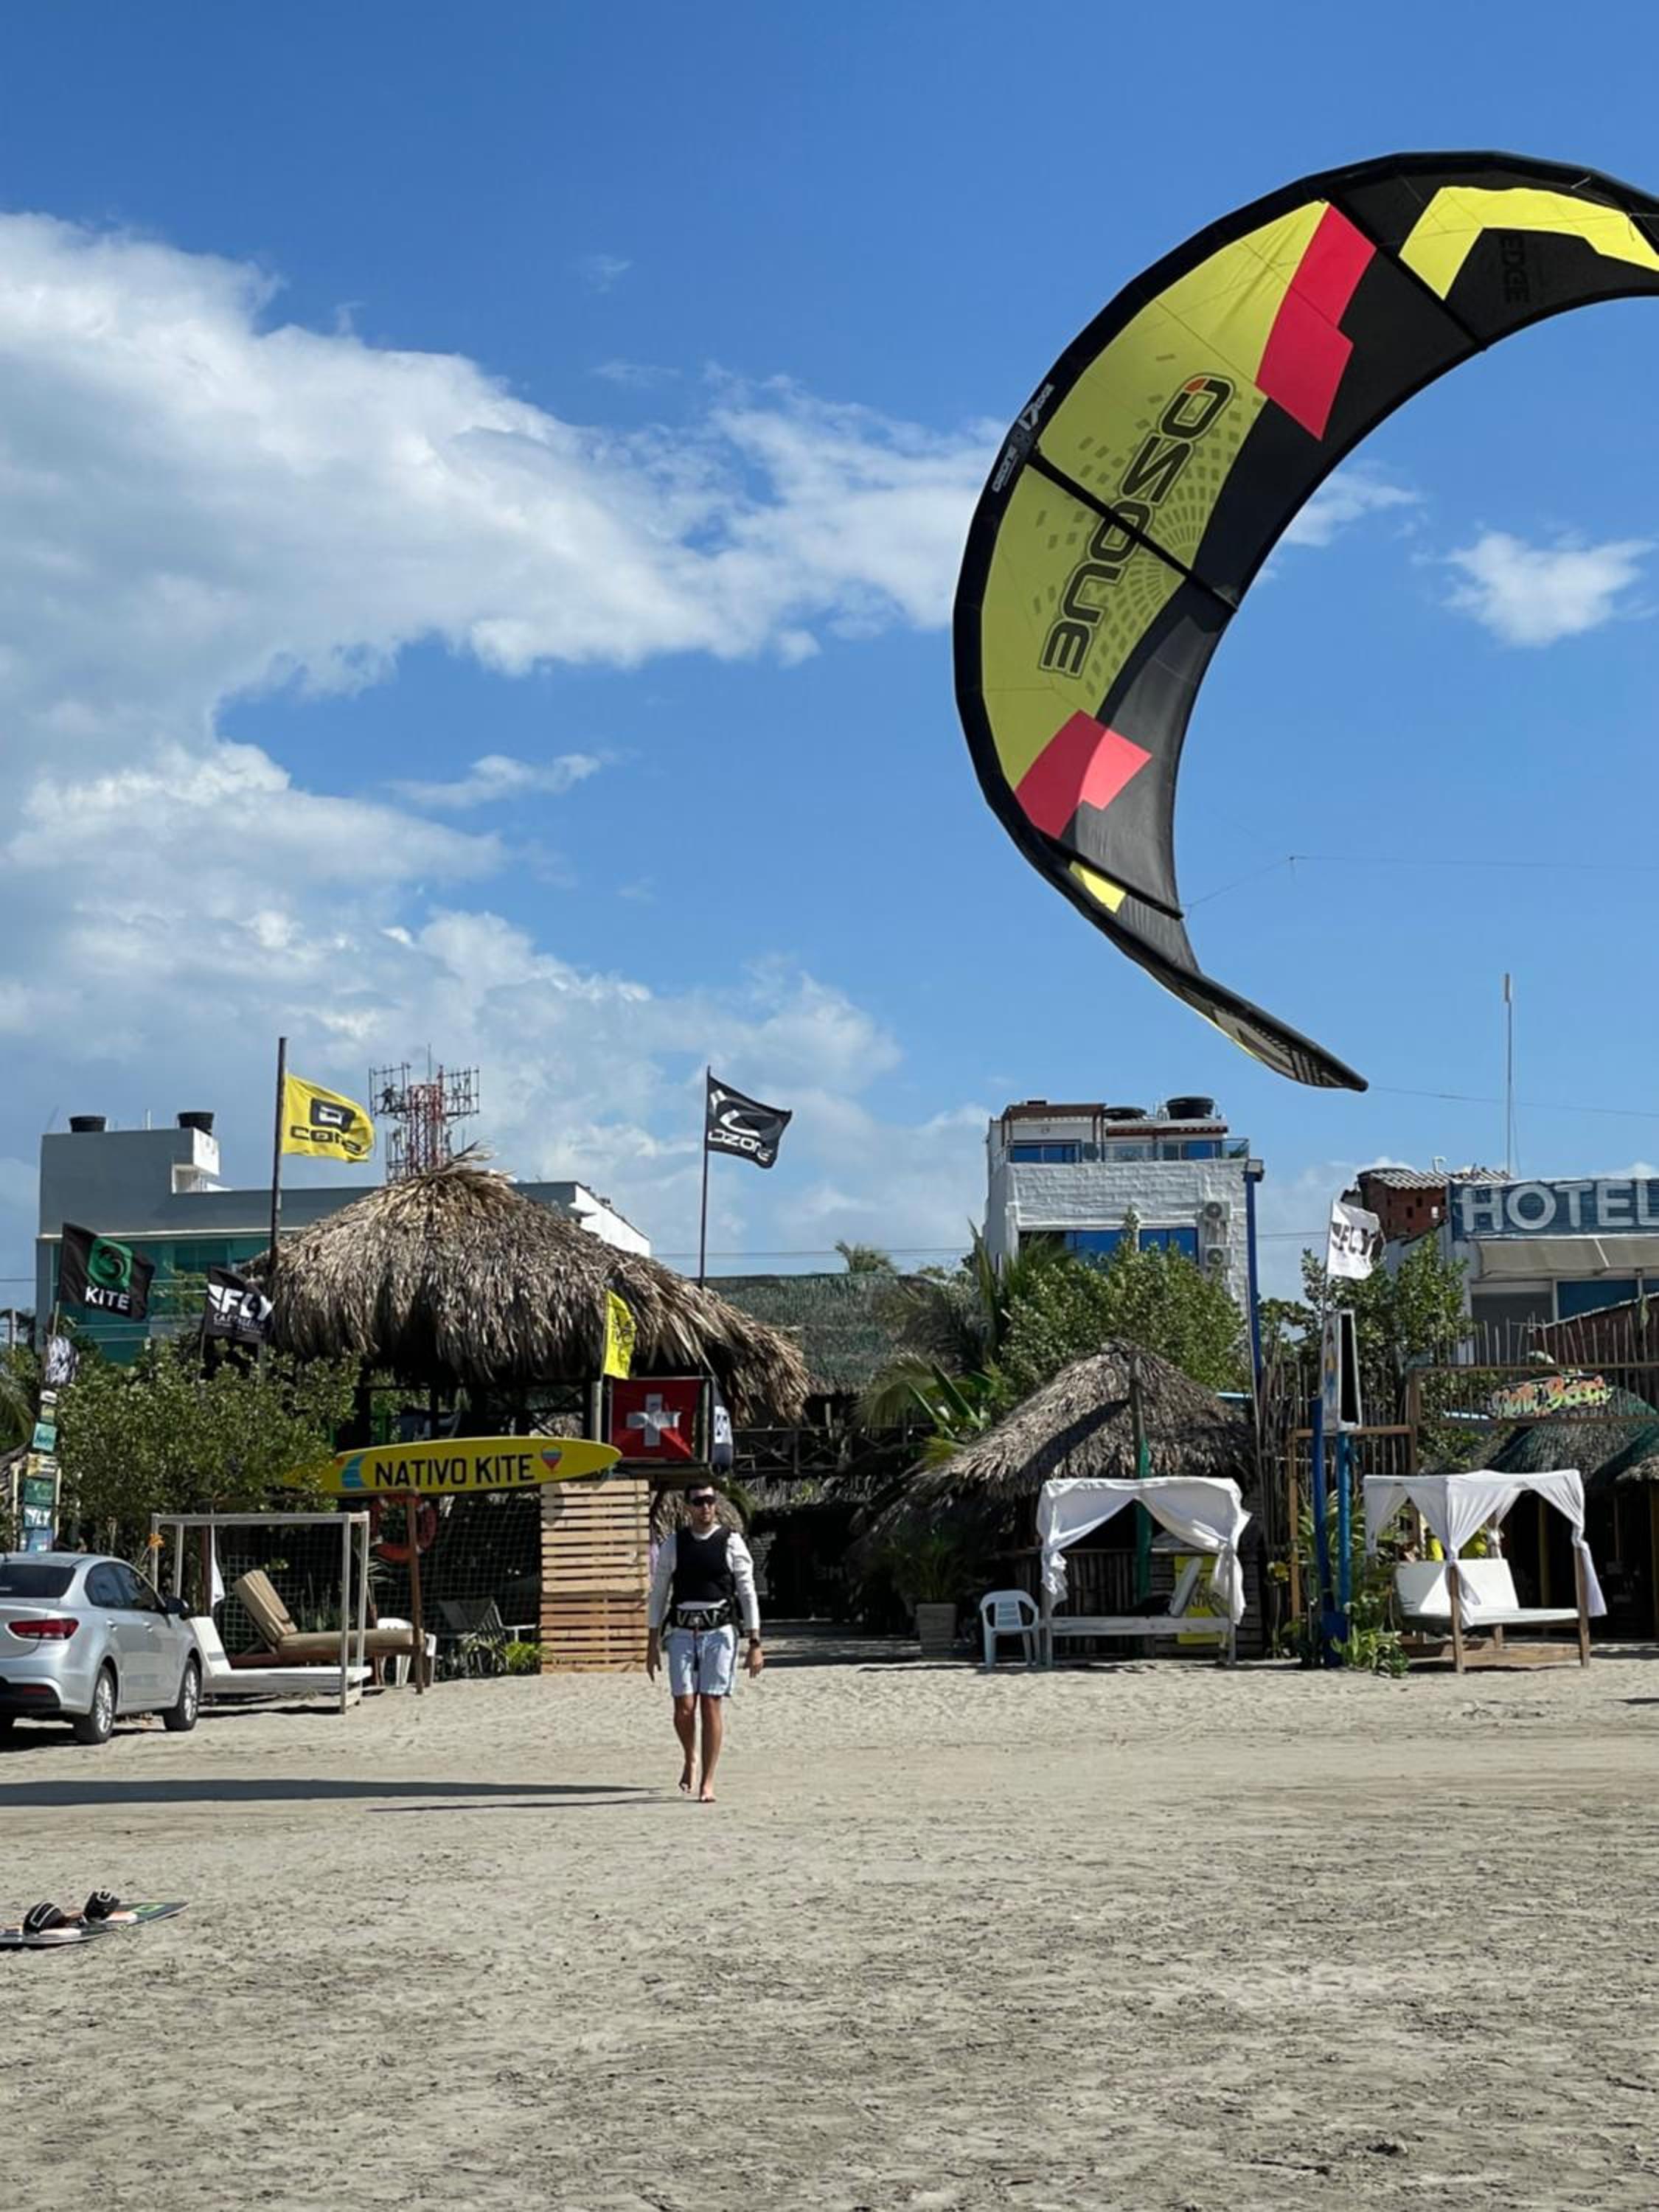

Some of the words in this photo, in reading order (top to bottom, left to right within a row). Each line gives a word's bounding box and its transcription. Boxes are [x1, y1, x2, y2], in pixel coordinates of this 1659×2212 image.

[1499, 234, 1530, 304] EDGE
[1461, 1180, 1659, 1233] HOTEL
[84, 1285, 131, 1310] KITE
[219, 1287, 272, 1322] FLY
[374, 1457, 466, 1487] NATIVO
[475, 1453, 535, 1484] KITE
